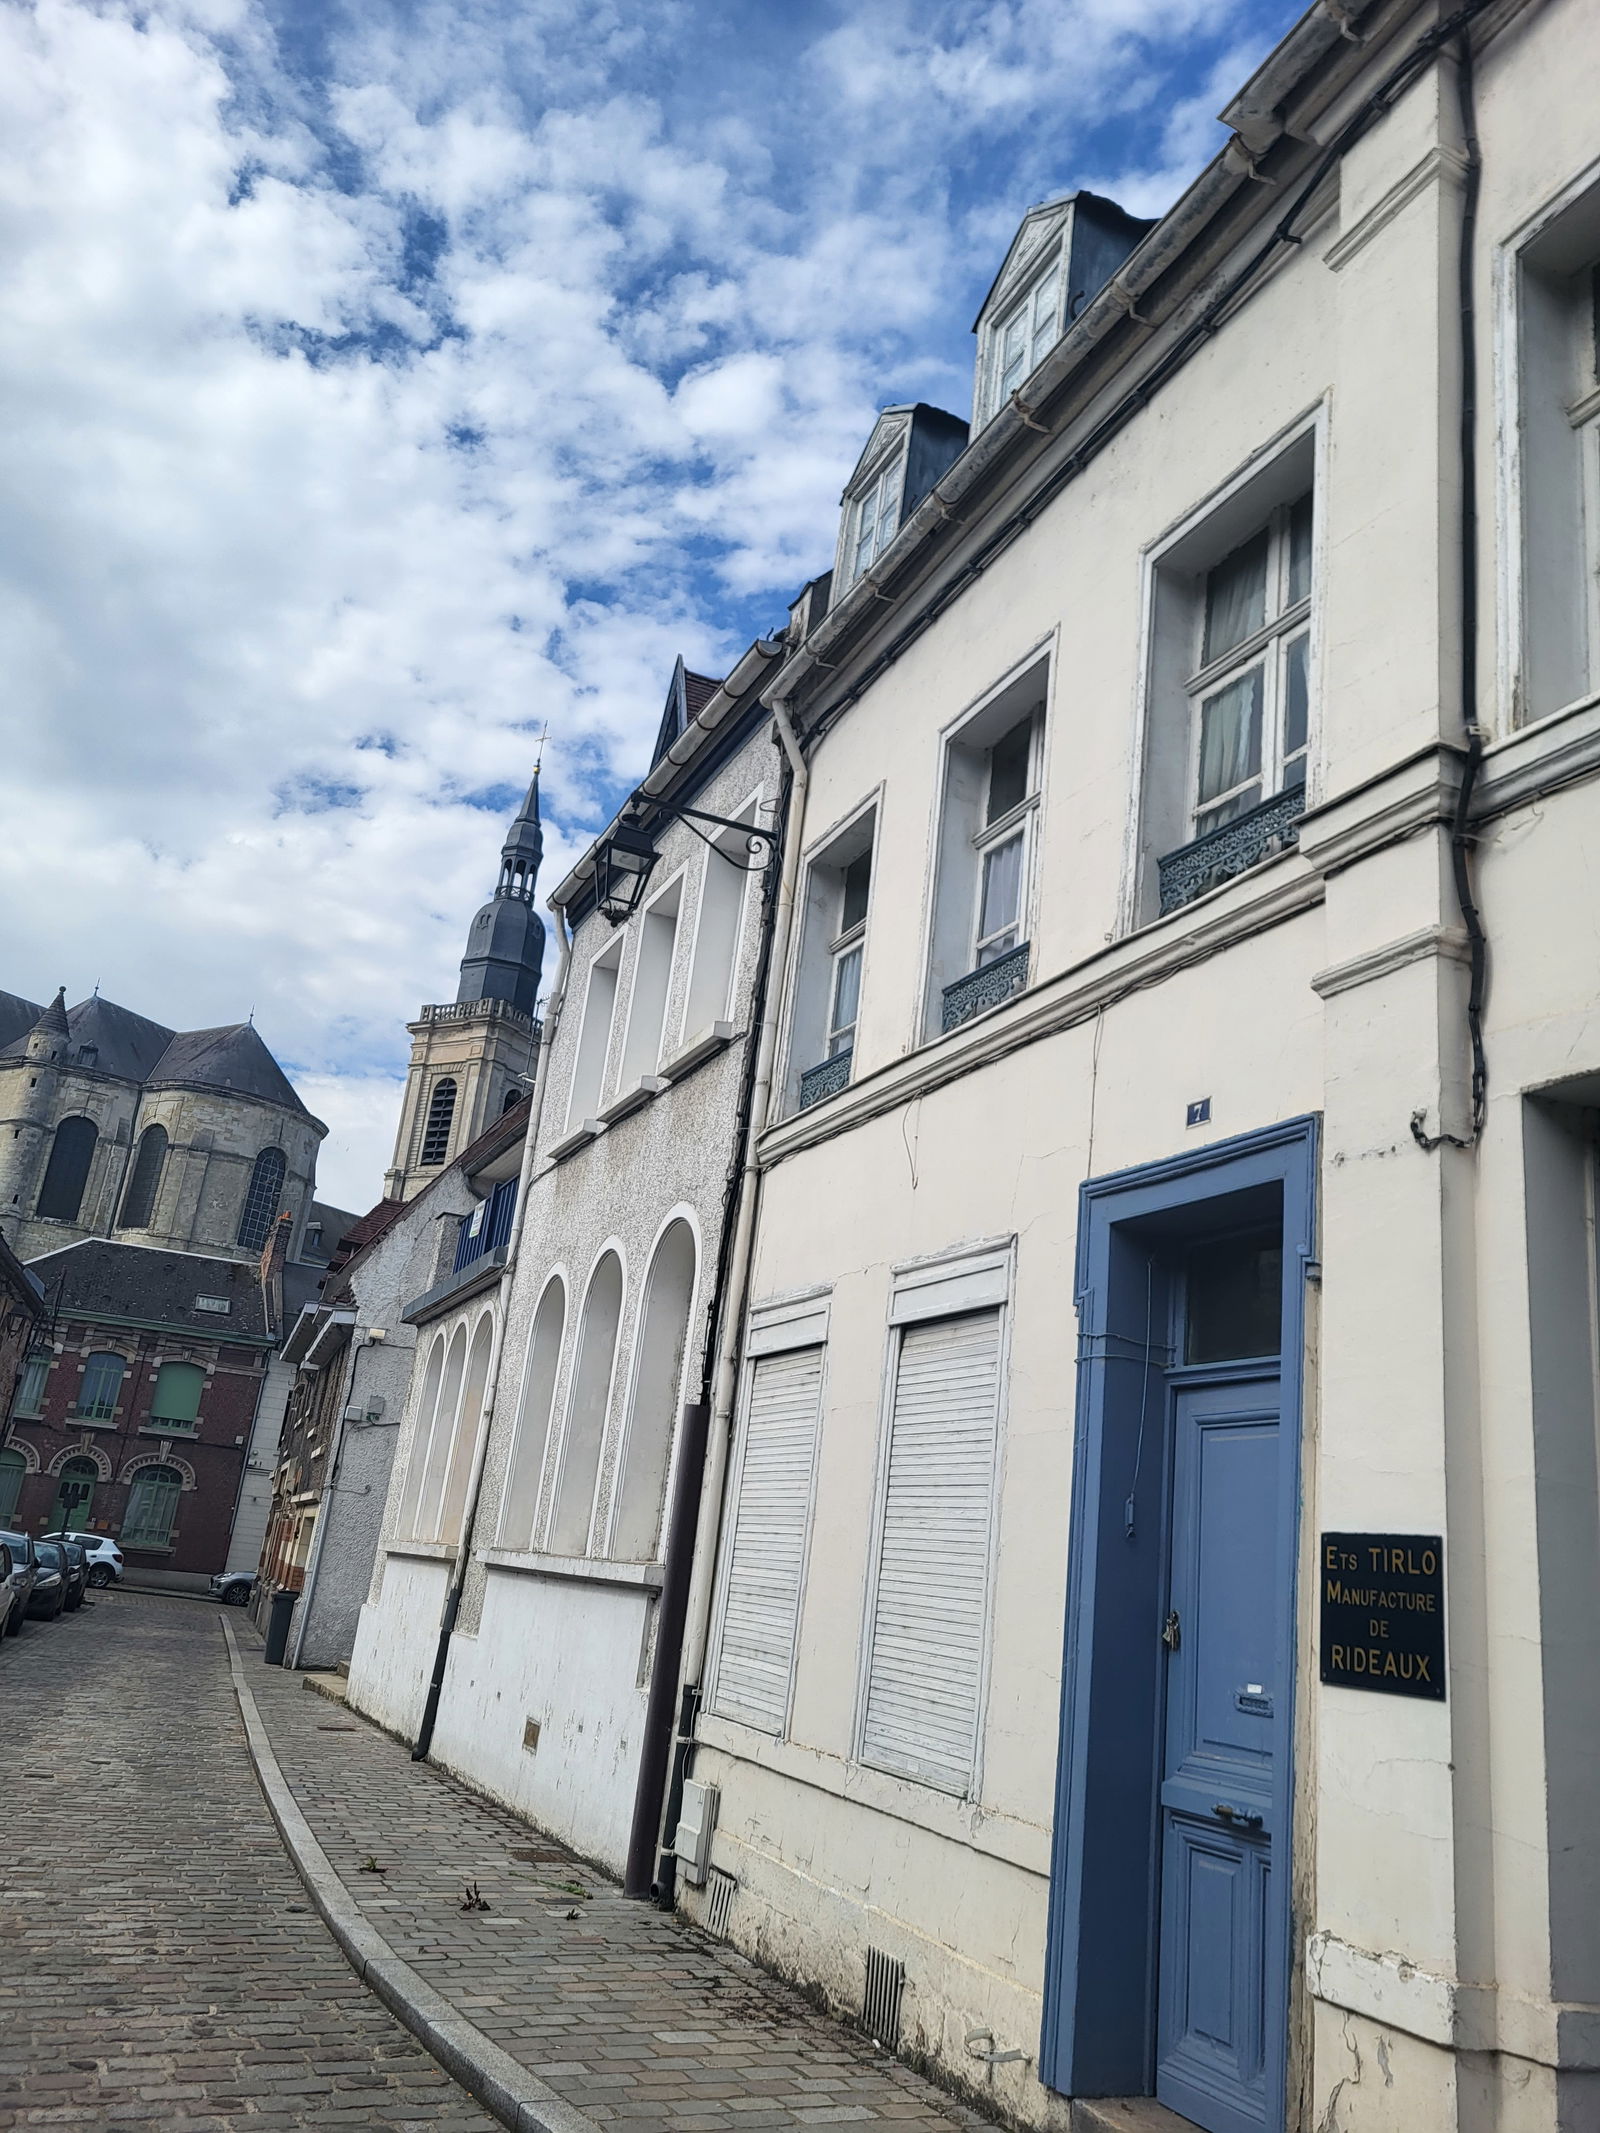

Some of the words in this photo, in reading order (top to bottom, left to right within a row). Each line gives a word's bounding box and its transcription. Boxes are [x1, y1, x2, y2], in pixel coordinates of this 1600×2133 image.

[1193, 1103, 1203, 1122] 7
[1368, 1547, 1436, 1575] TIRLO
[1327, 1579, 1436, 1612] MANUFACTURE
[1369, 1619, 1390, 1638] DE
[1331, 1644, 1431, 1682] RIDEAUX
